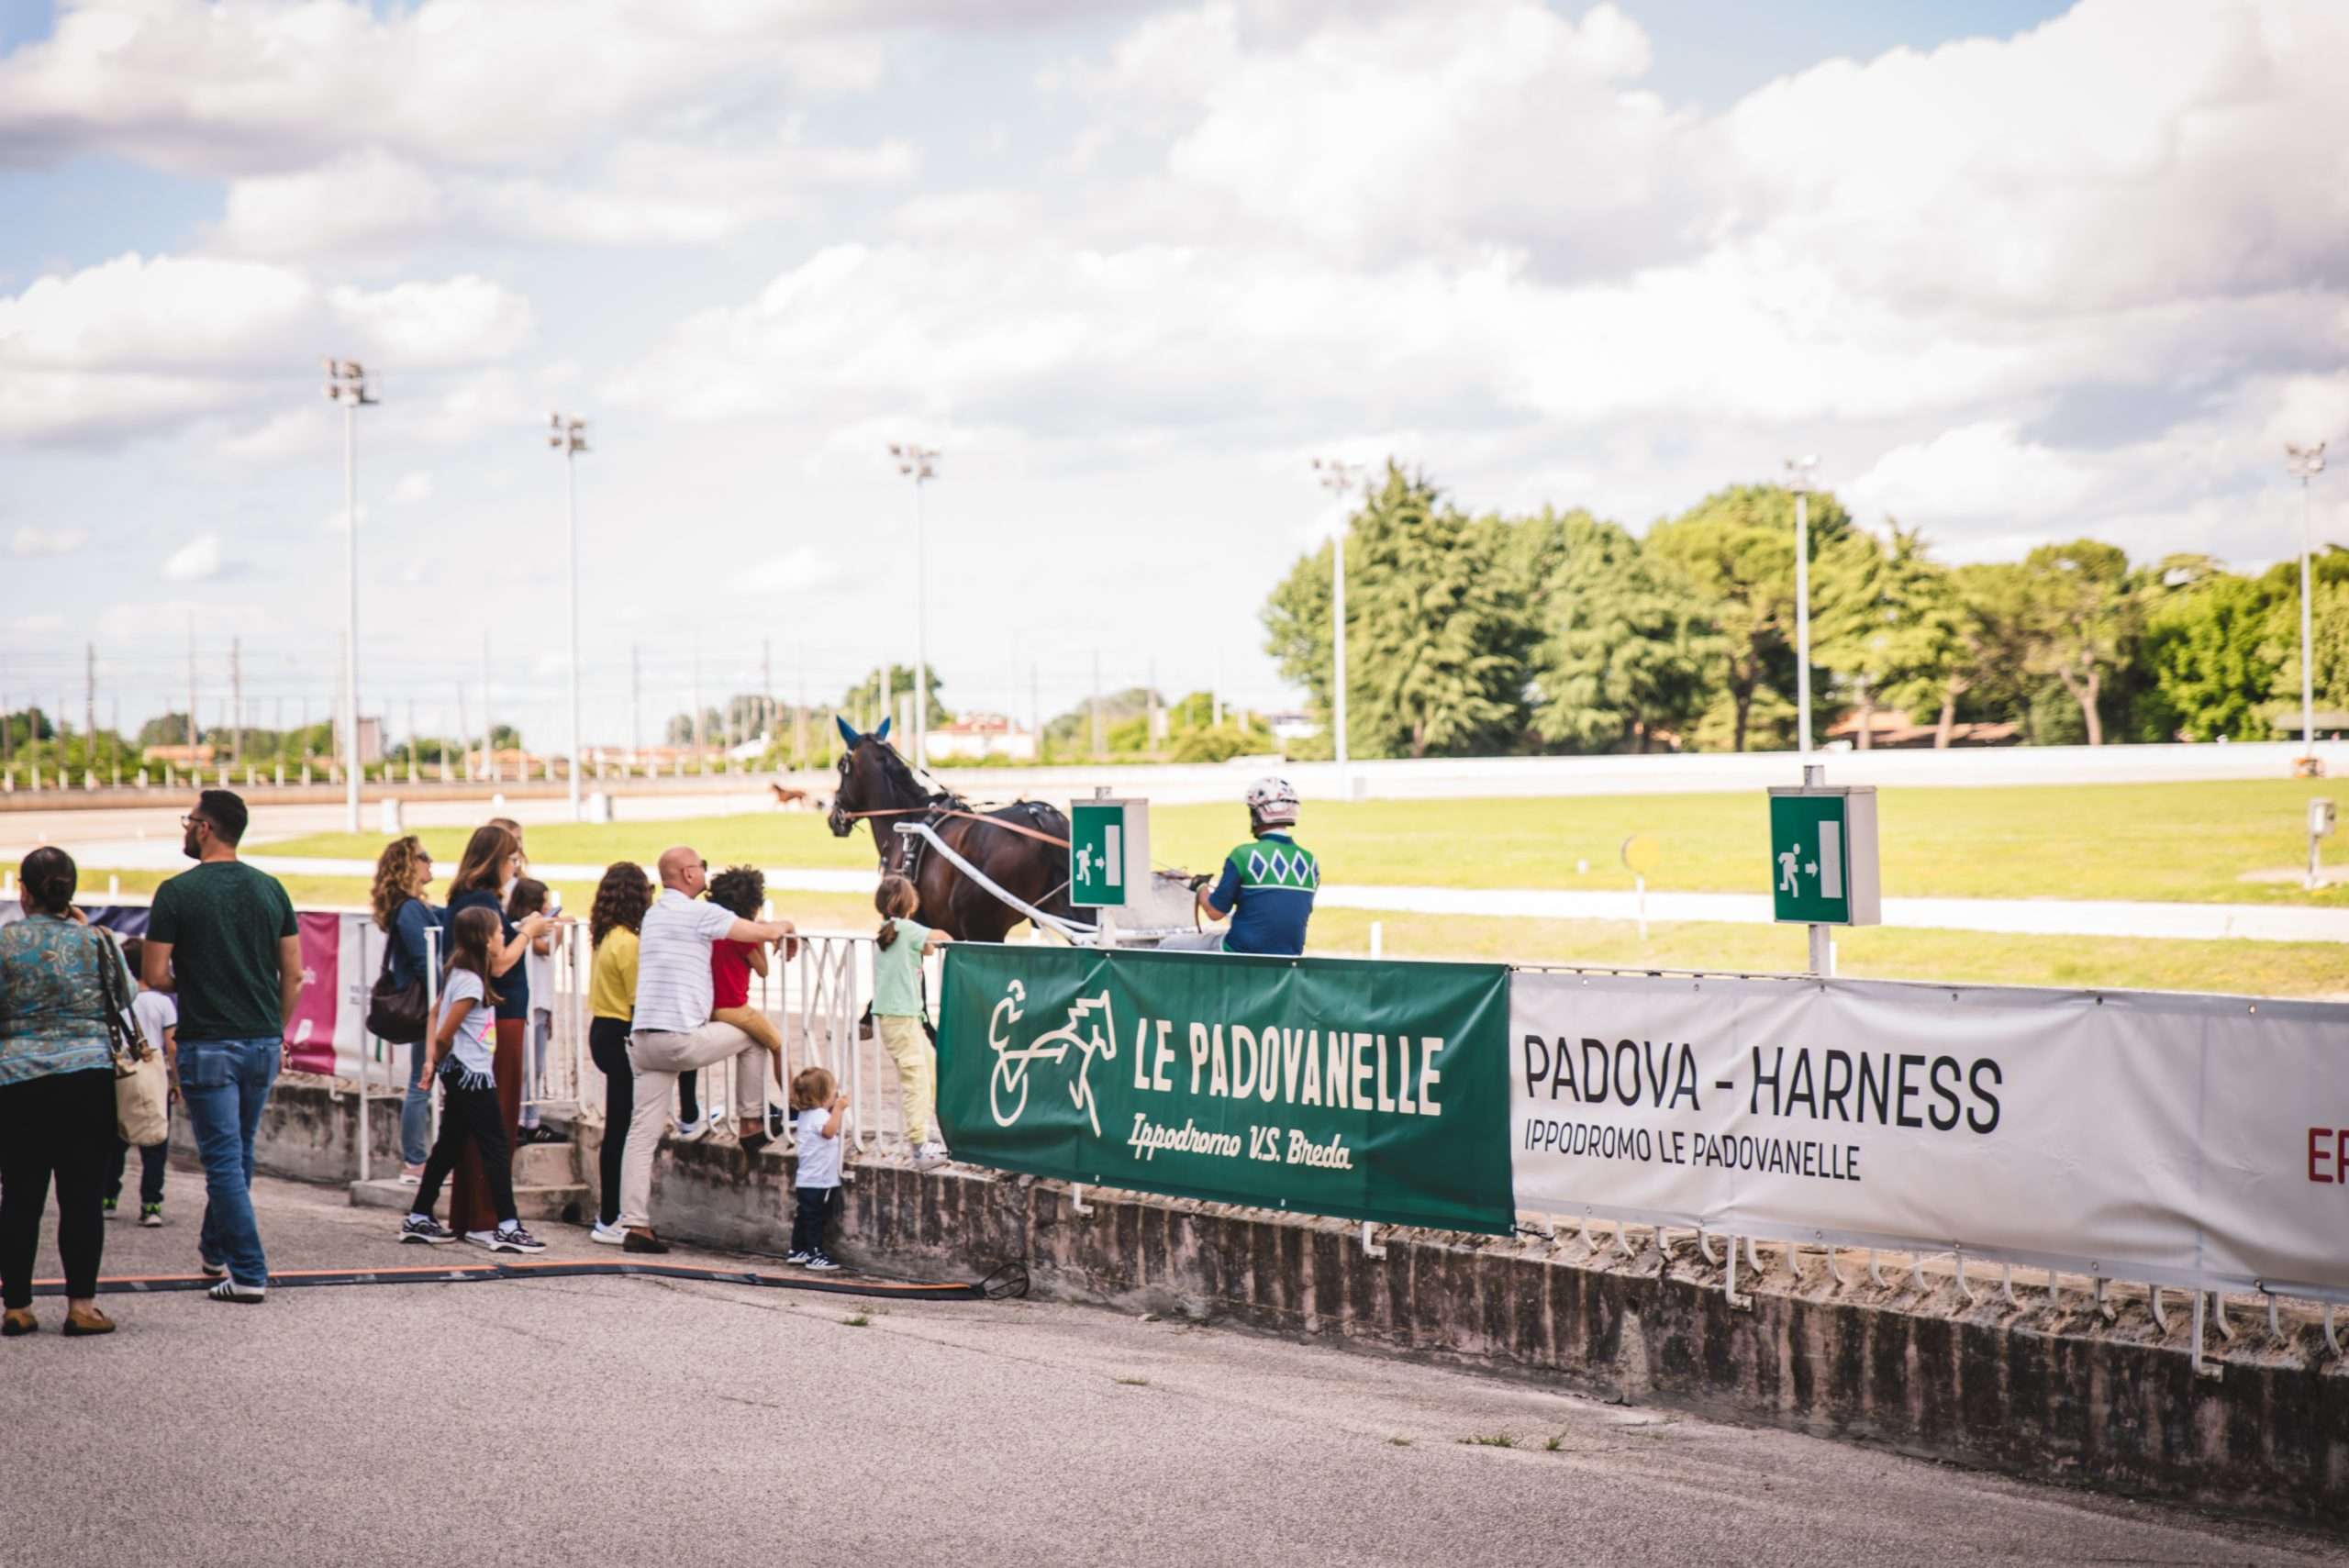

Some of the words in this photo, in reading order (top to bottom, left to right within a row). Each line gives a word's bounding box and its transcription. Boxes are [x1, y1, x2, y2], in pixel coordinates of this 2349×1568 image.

[1133, 1018, 1175, 1092] LE
[1189, 1022, 1444, 1116] PADOVANELLE
[1525, 1034, 1700, 1110] PADOVA
[1750, 1045, 2003, 1134] HARNESS
[1128, 1112, 1241, 1162] Ippodromo
[1249, 1125, 1281, 1162] V.S.
[1286, 1129, 1353, 1170] Breda
[1525, 1118, 1652, 1162] IPPODROMO
[1658, 1129, 1686, 1164] LE
[1692, 1133, 1861, 1182] PADOVANELLE
